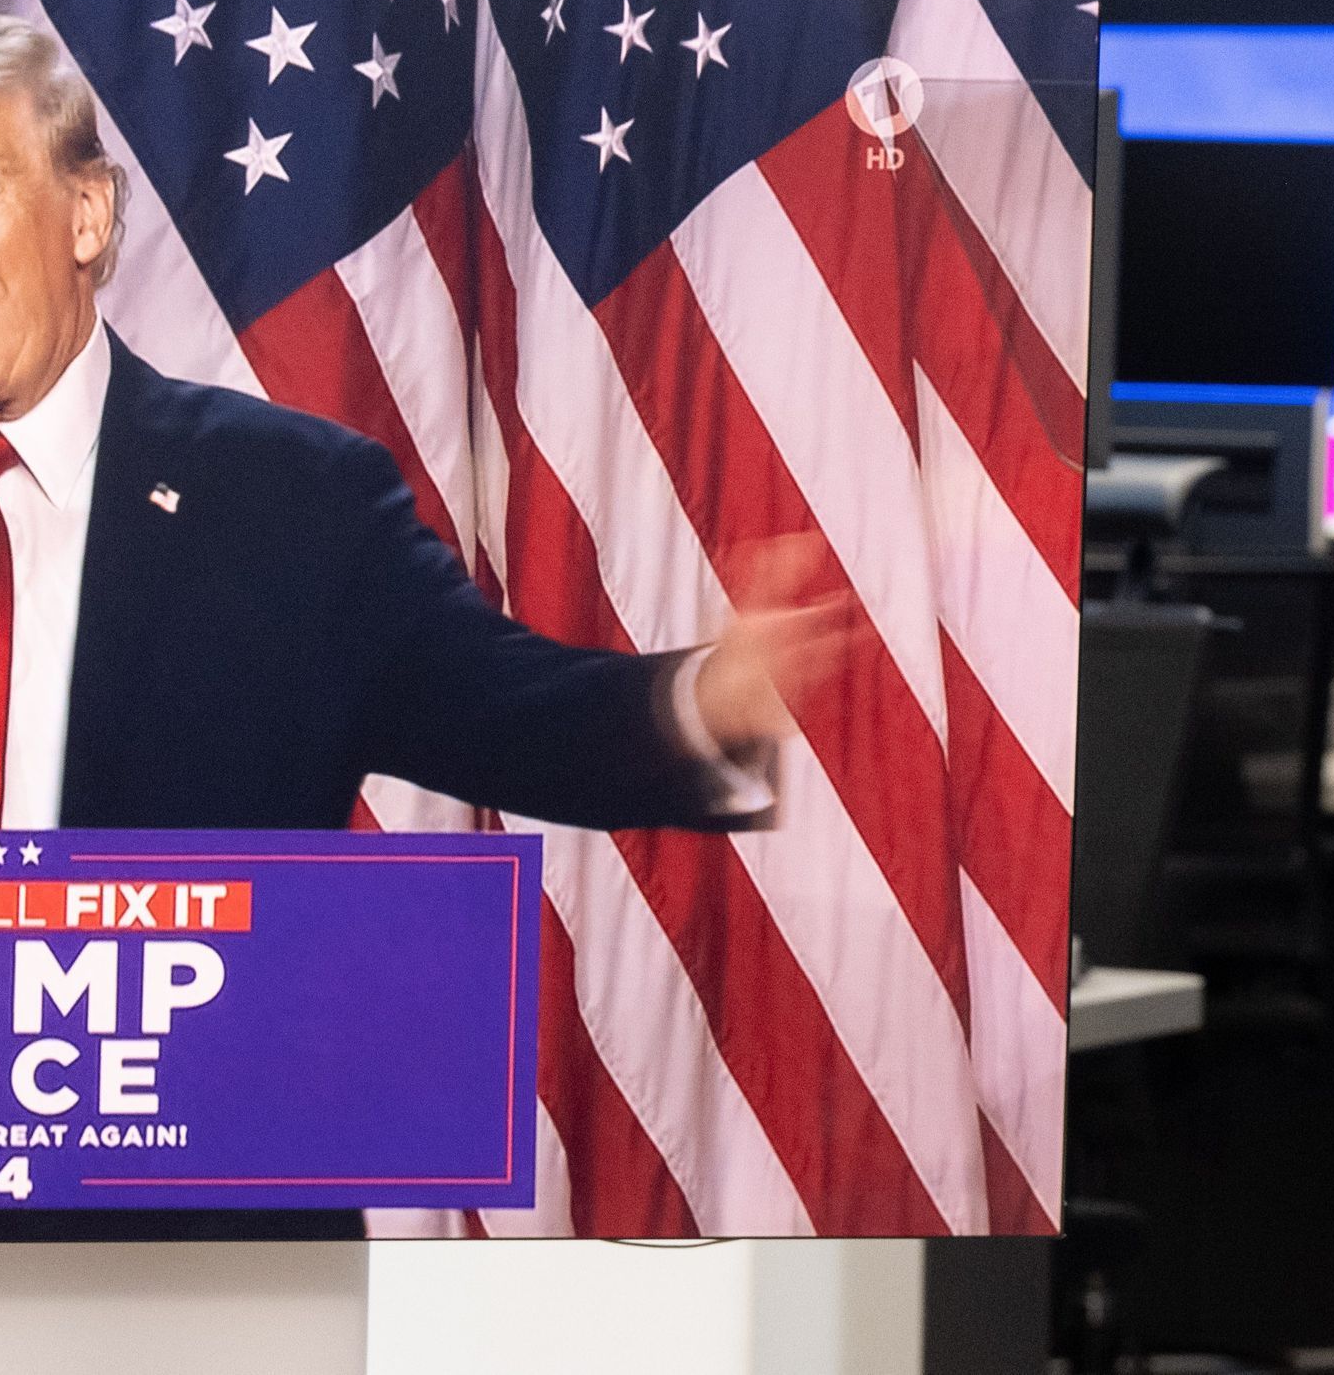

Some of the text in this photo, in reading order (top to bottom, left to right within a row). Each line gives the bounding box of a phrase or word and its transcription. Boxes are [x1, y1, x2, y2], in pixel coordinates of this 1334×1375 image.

[866, 146, 905, 171] HD
[66, 884, 157, 928] FIX
[175, 885, 227, 928] IT
[79, 1125, 188, 1148] AGAIN!
